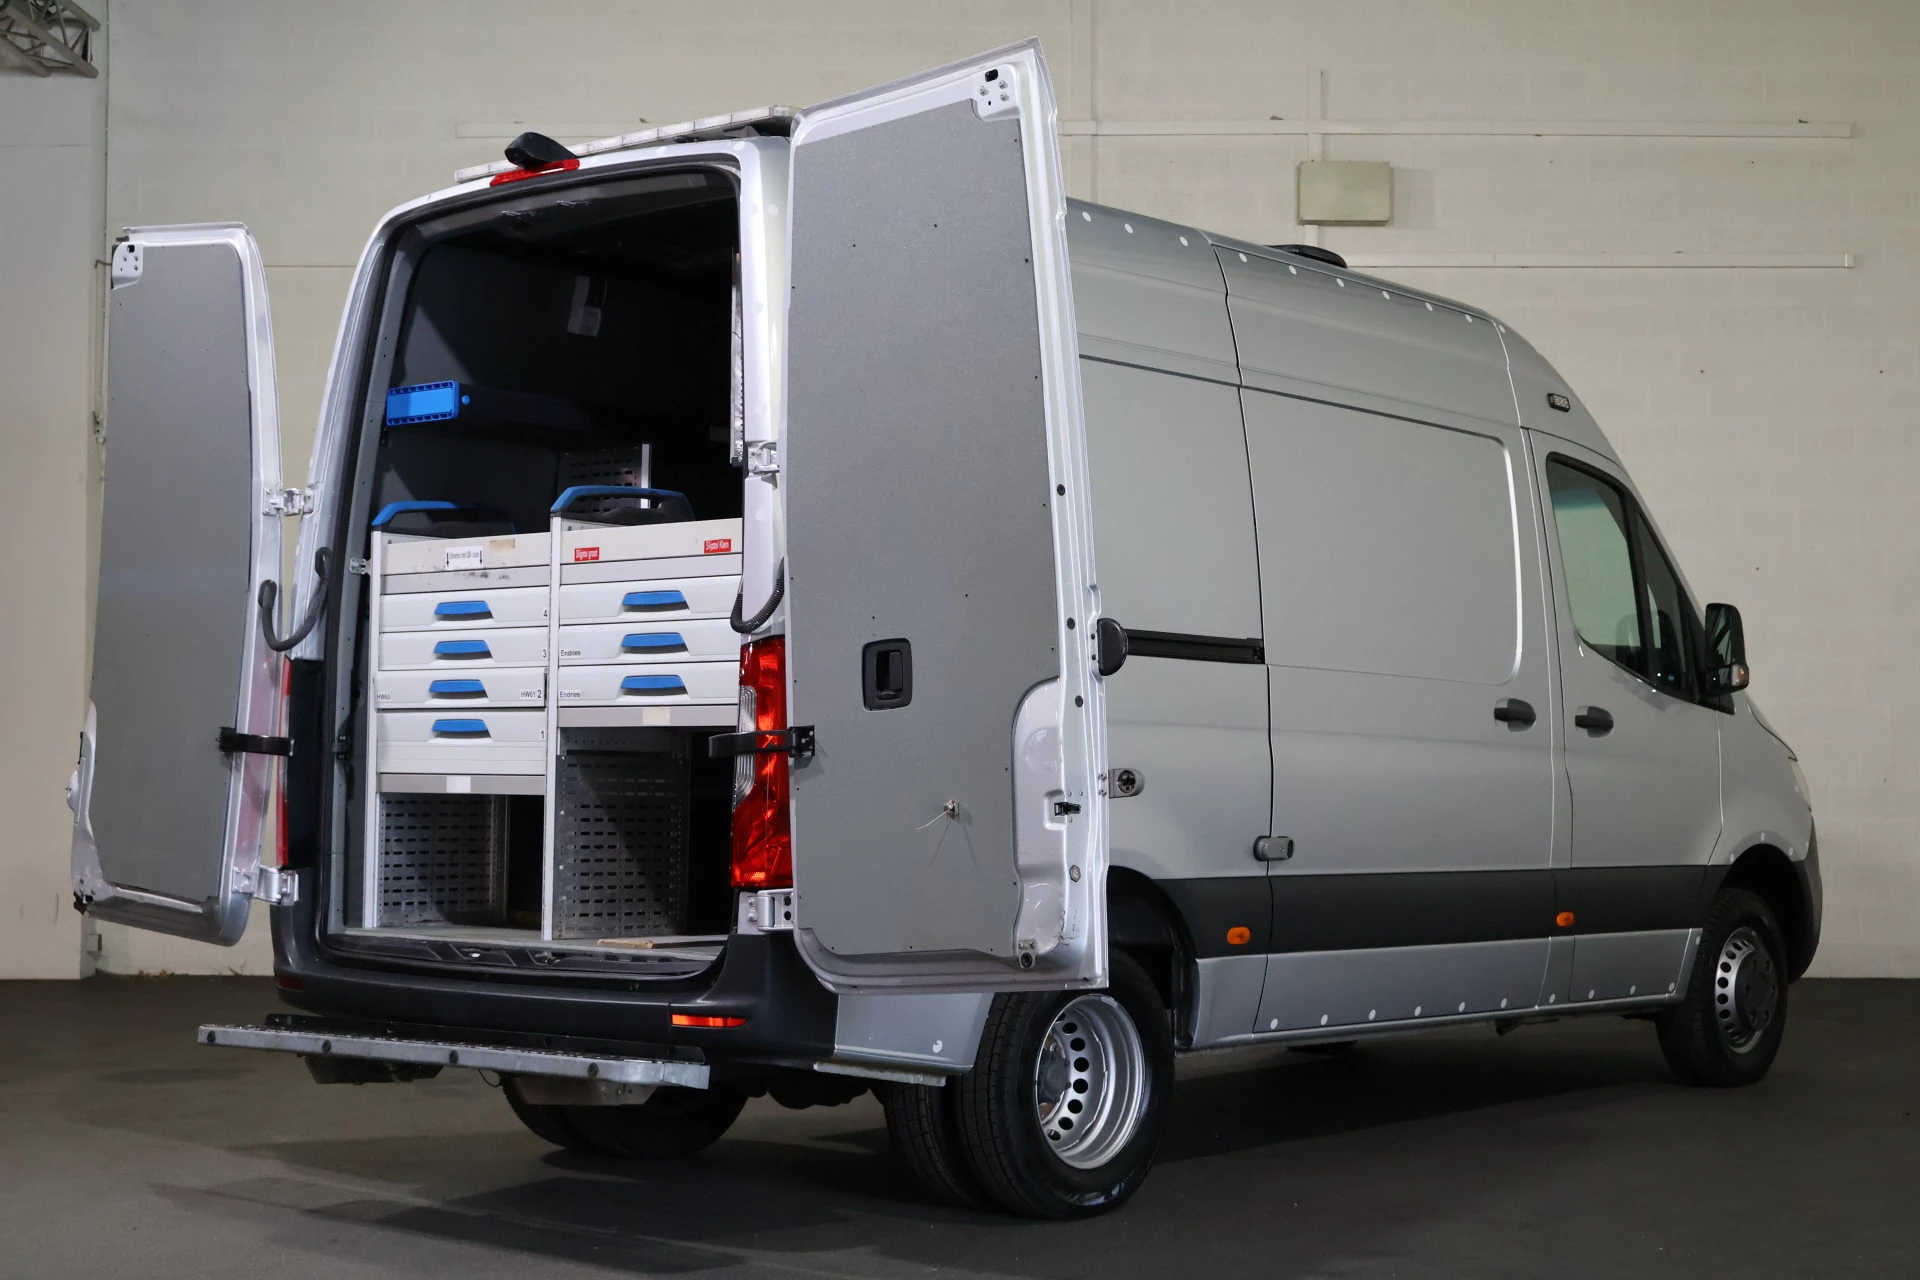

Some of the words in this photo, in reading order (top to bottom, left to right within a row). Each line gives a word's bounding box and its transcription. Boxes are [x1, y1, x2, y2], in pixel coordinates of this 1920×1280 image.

[543, 609, 548, 617] 4
[542, 649, 547, 658] 3
[537, 689, 542, 699] 2
